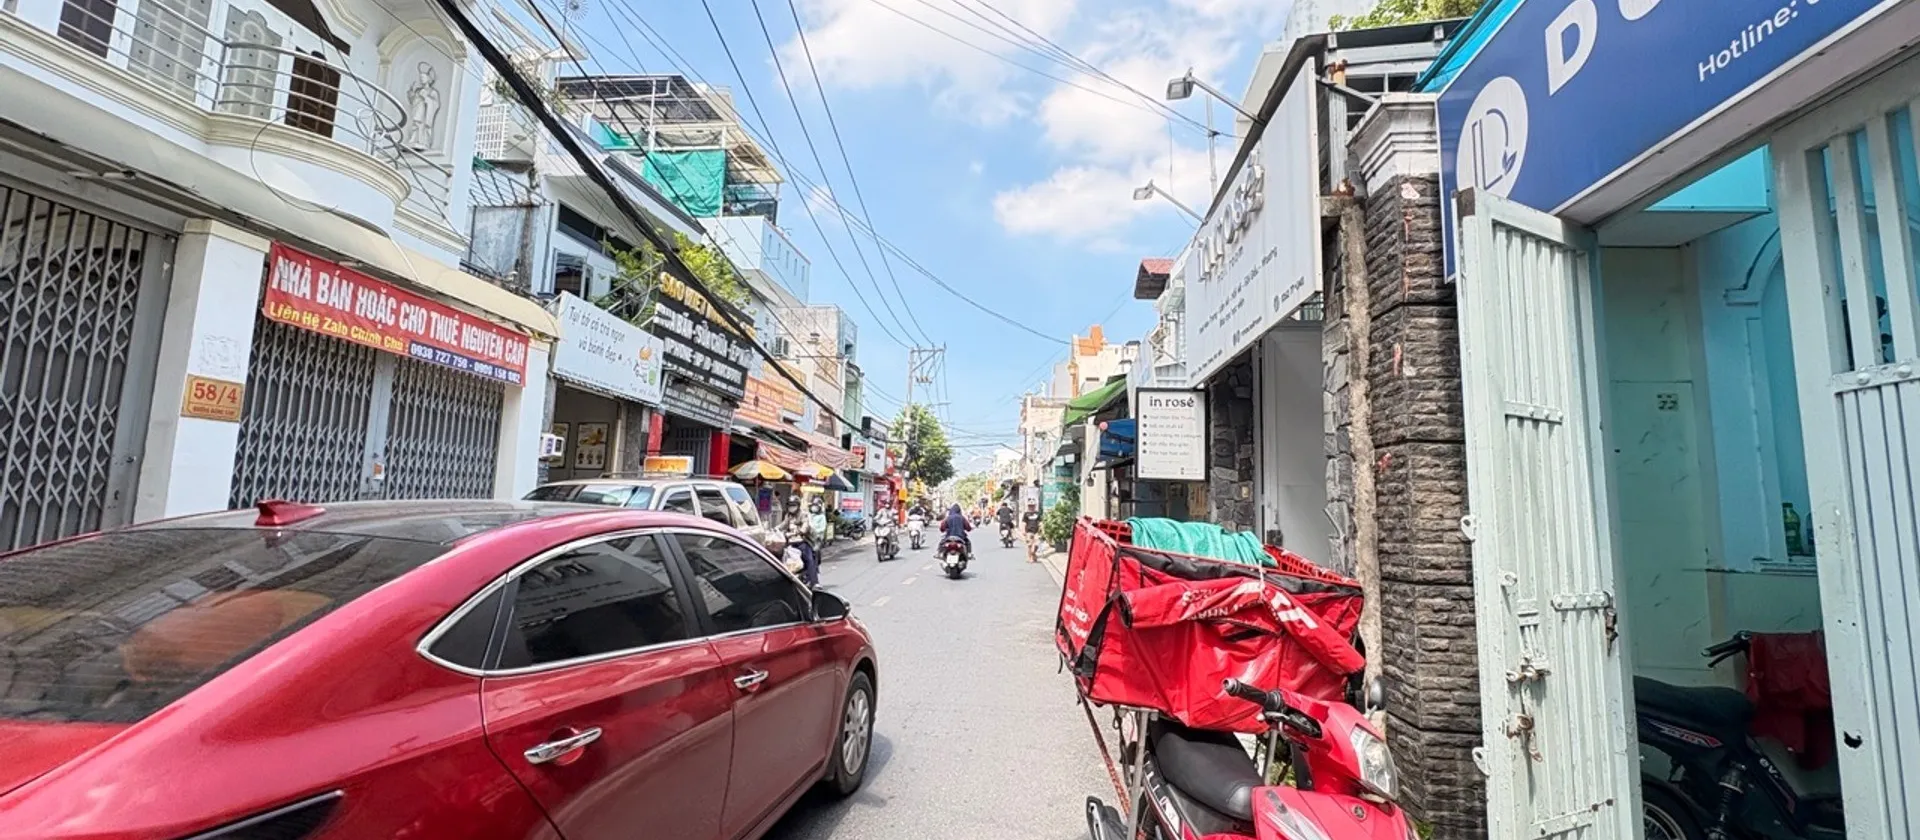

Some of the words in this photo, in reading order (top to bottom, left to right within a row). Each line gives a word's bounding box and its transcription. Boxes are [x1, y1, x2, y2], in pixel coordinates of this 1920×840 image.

[1698, 0, 1799, 82] Hotline:
[660, 271, 685, 301] SAO
[269, 301, 300, 320] Liên
[303, 310, 321, 331] Hệ
[322, 316, 348, 336] Zalo
[350, 325, 382, 345] Chính
[410, 343, 434, 360] 0938
[435, 349, 451, 363] 727
[271, 255, 312, 300] NHÀ
[316, 270, 353, 312] BÁN
[356, 286, 397, 329] HOẶC
[399, 301, 428, 335] CHO
[429, 314, 459, 346] THUÊ
[461, 322, 505, 359] NGUYÊN
[504, 337, 526, 367] CĂN
[194, 382, 237, 404] 58/4
[1149, 396, 1162, 407] in
[1165, 396, 1195, 407] rosé
